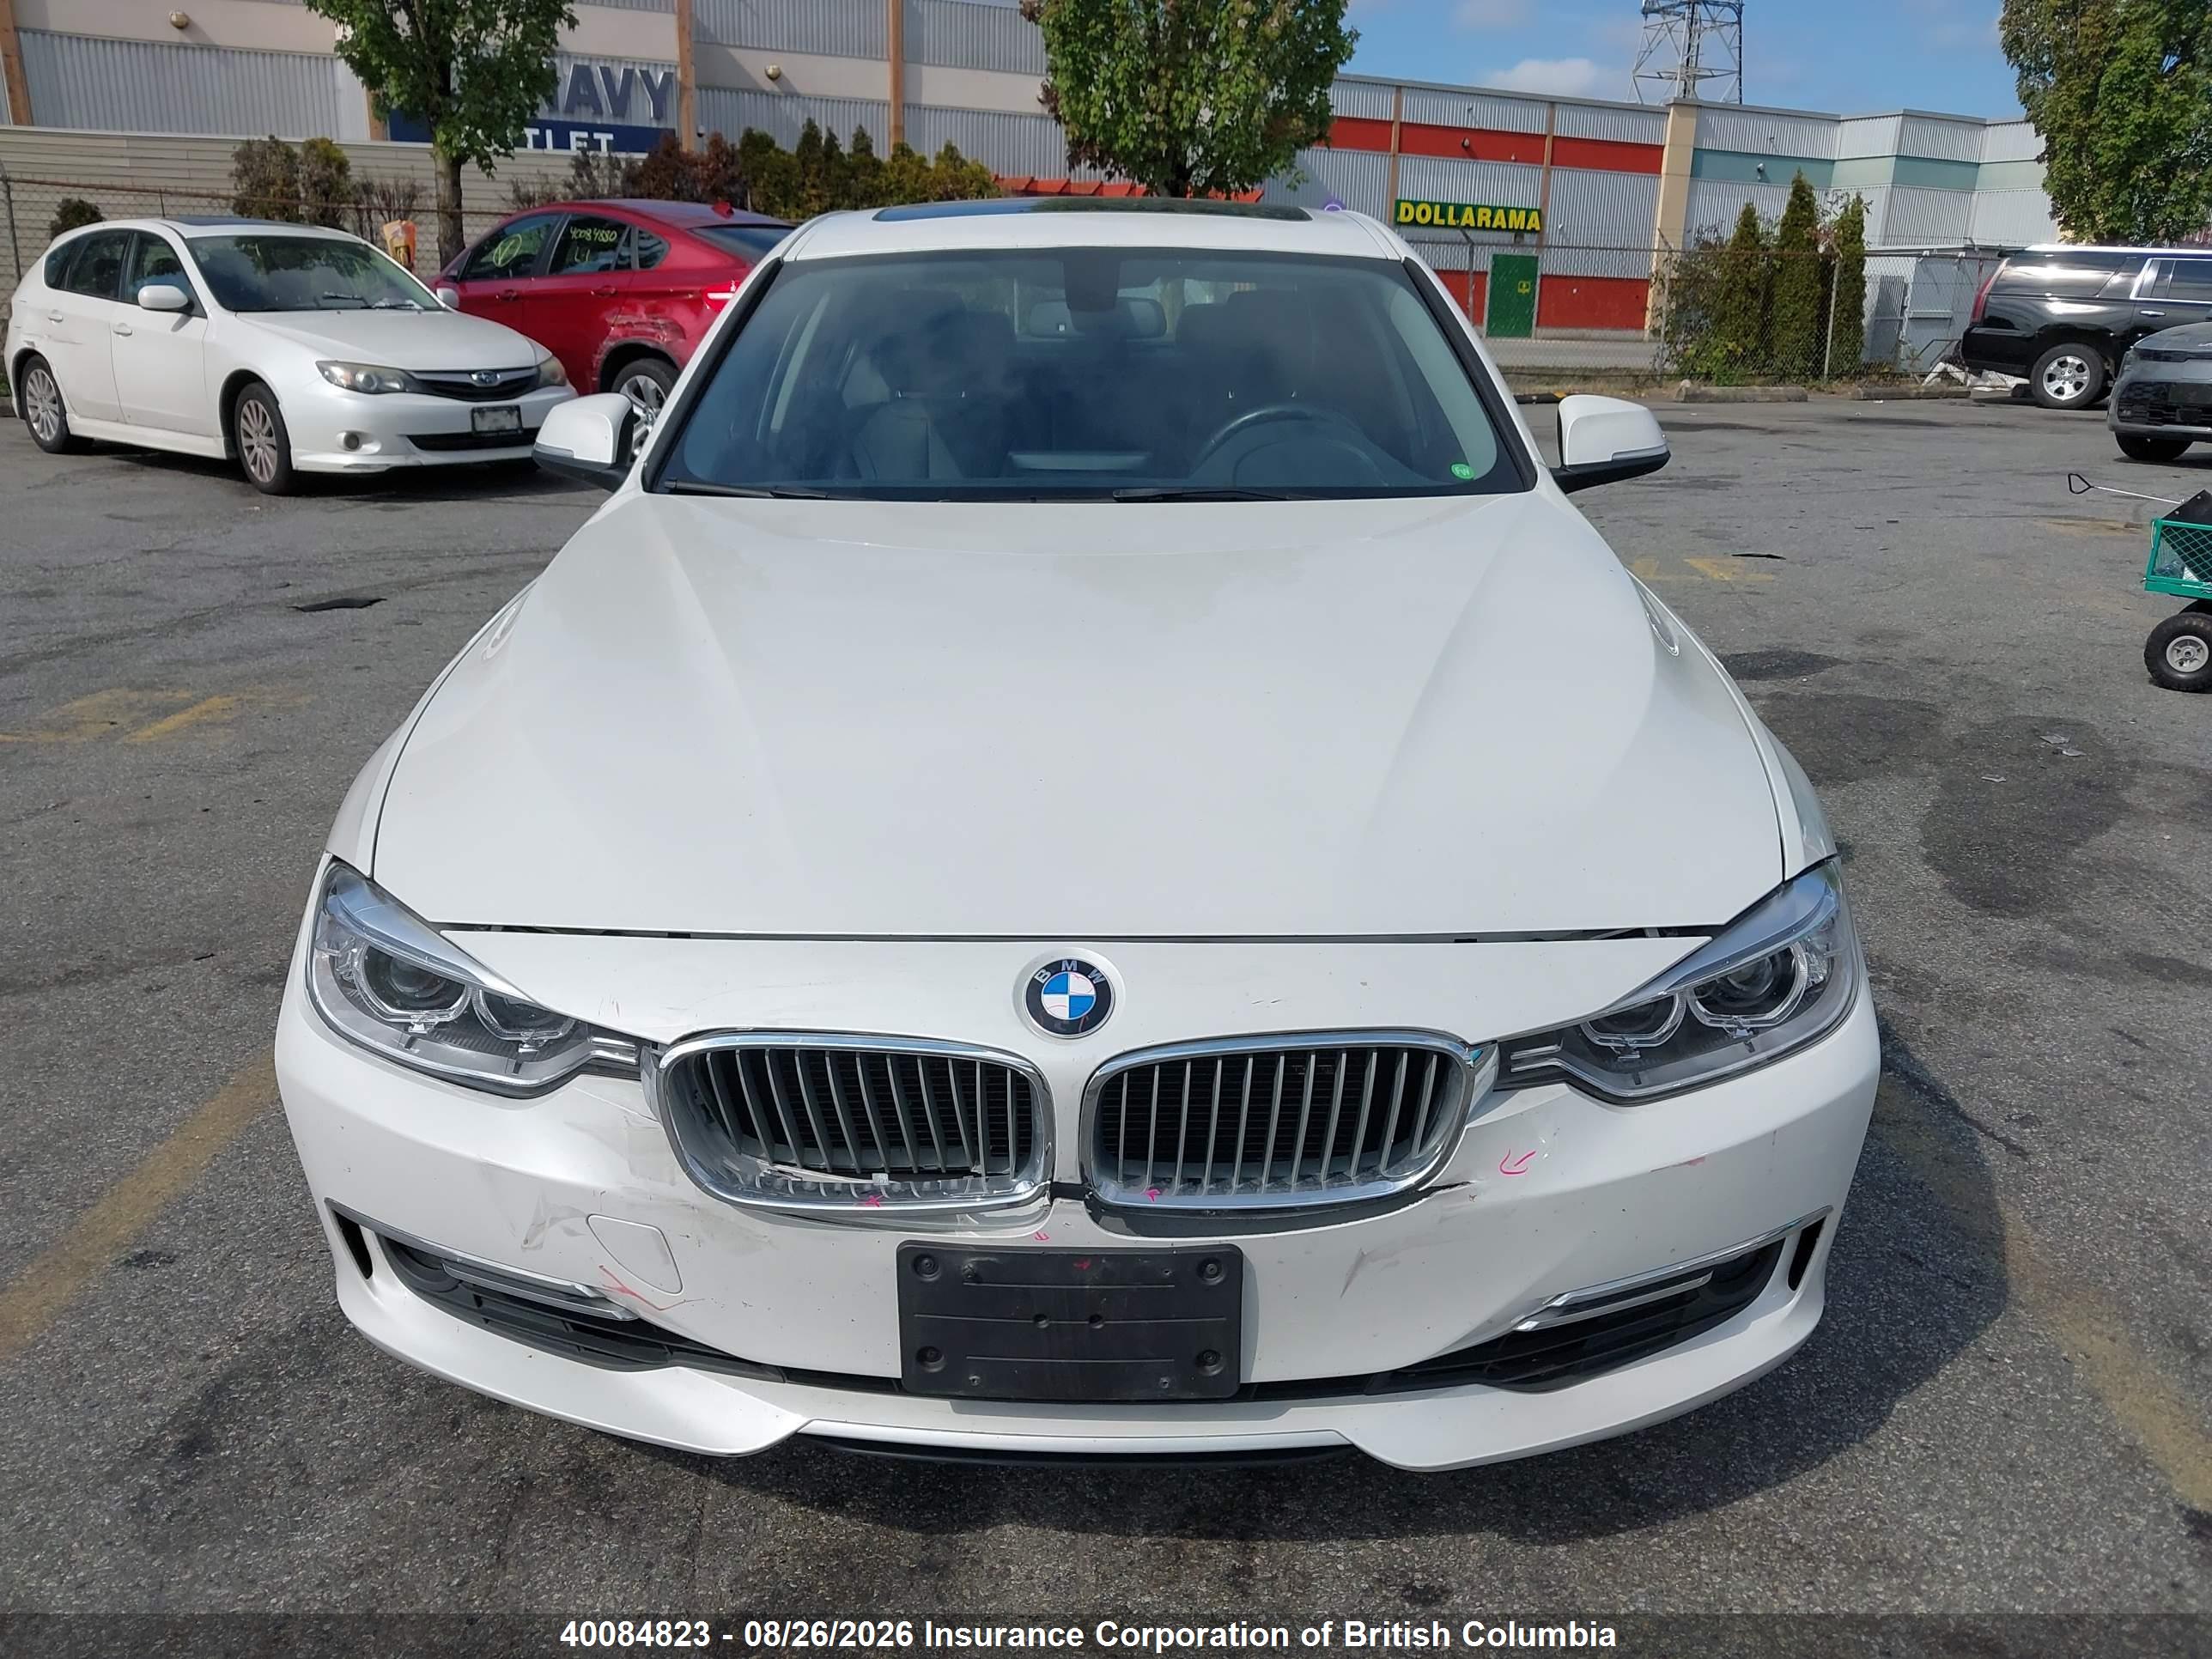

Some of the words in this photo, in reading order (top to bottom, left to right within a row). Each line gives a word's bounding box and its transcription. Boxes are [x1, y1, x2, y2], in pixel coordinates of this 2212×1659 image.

[538, 63, 675, 120] AVY
[1398, 202, 1541, 232] DOLLARAMA
[1034, 960, 1106, 984] BMW
